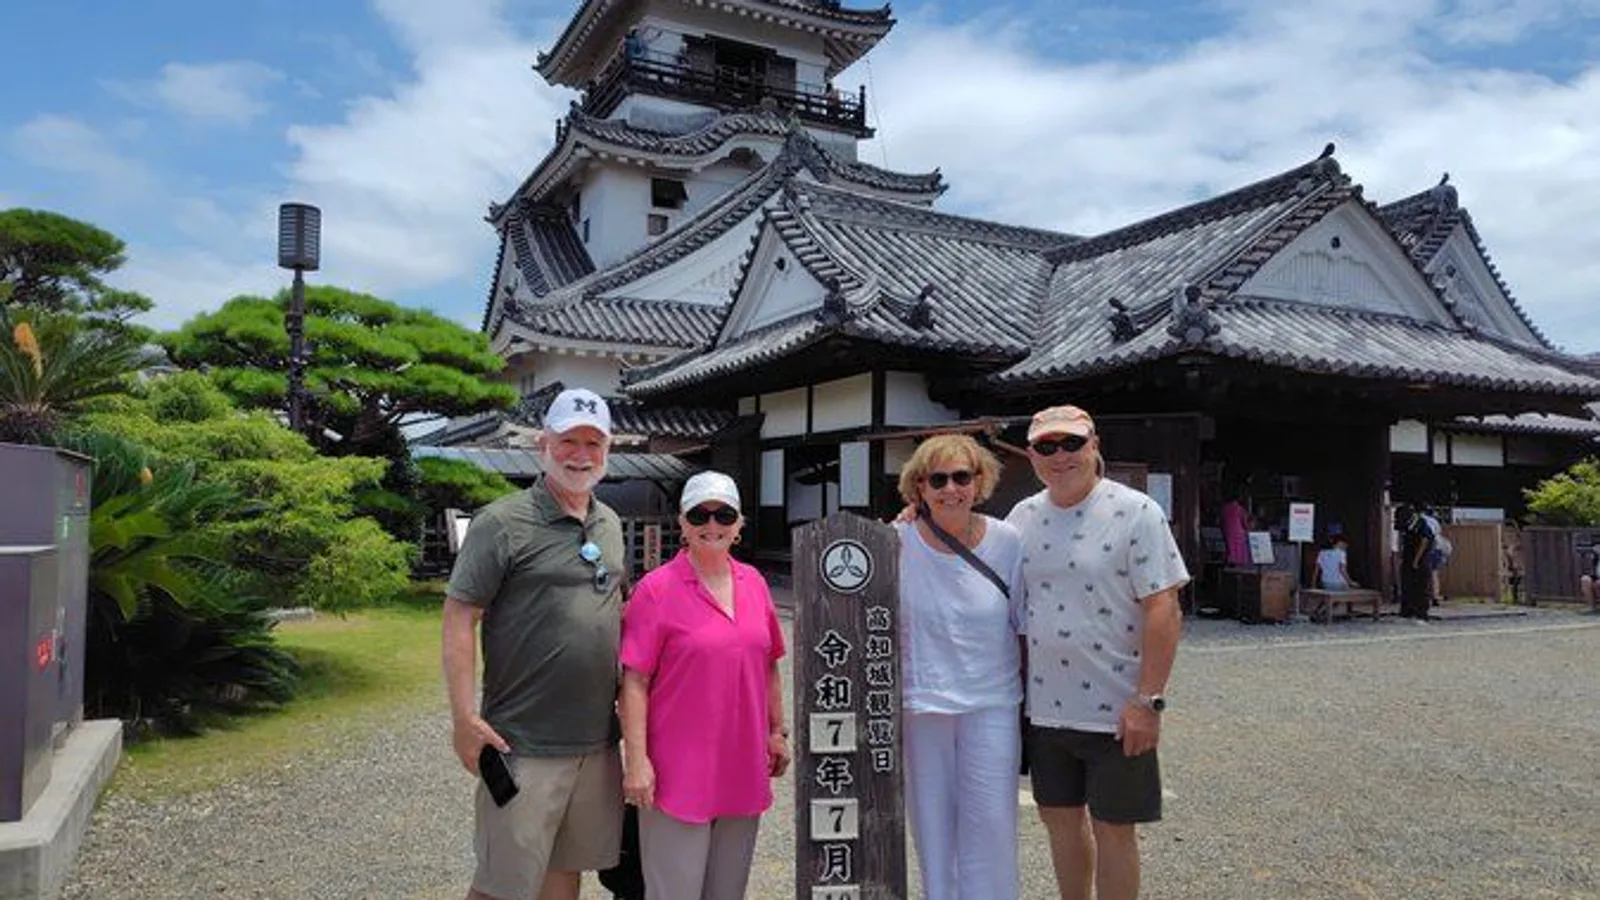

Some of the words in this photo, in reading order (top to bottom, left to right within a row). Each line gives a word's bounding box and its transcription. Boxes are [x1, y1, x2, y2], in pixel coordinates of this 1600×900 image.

[573, 398, 597, 414] M
[867, 606, 893, 771] 高知城観覧日
